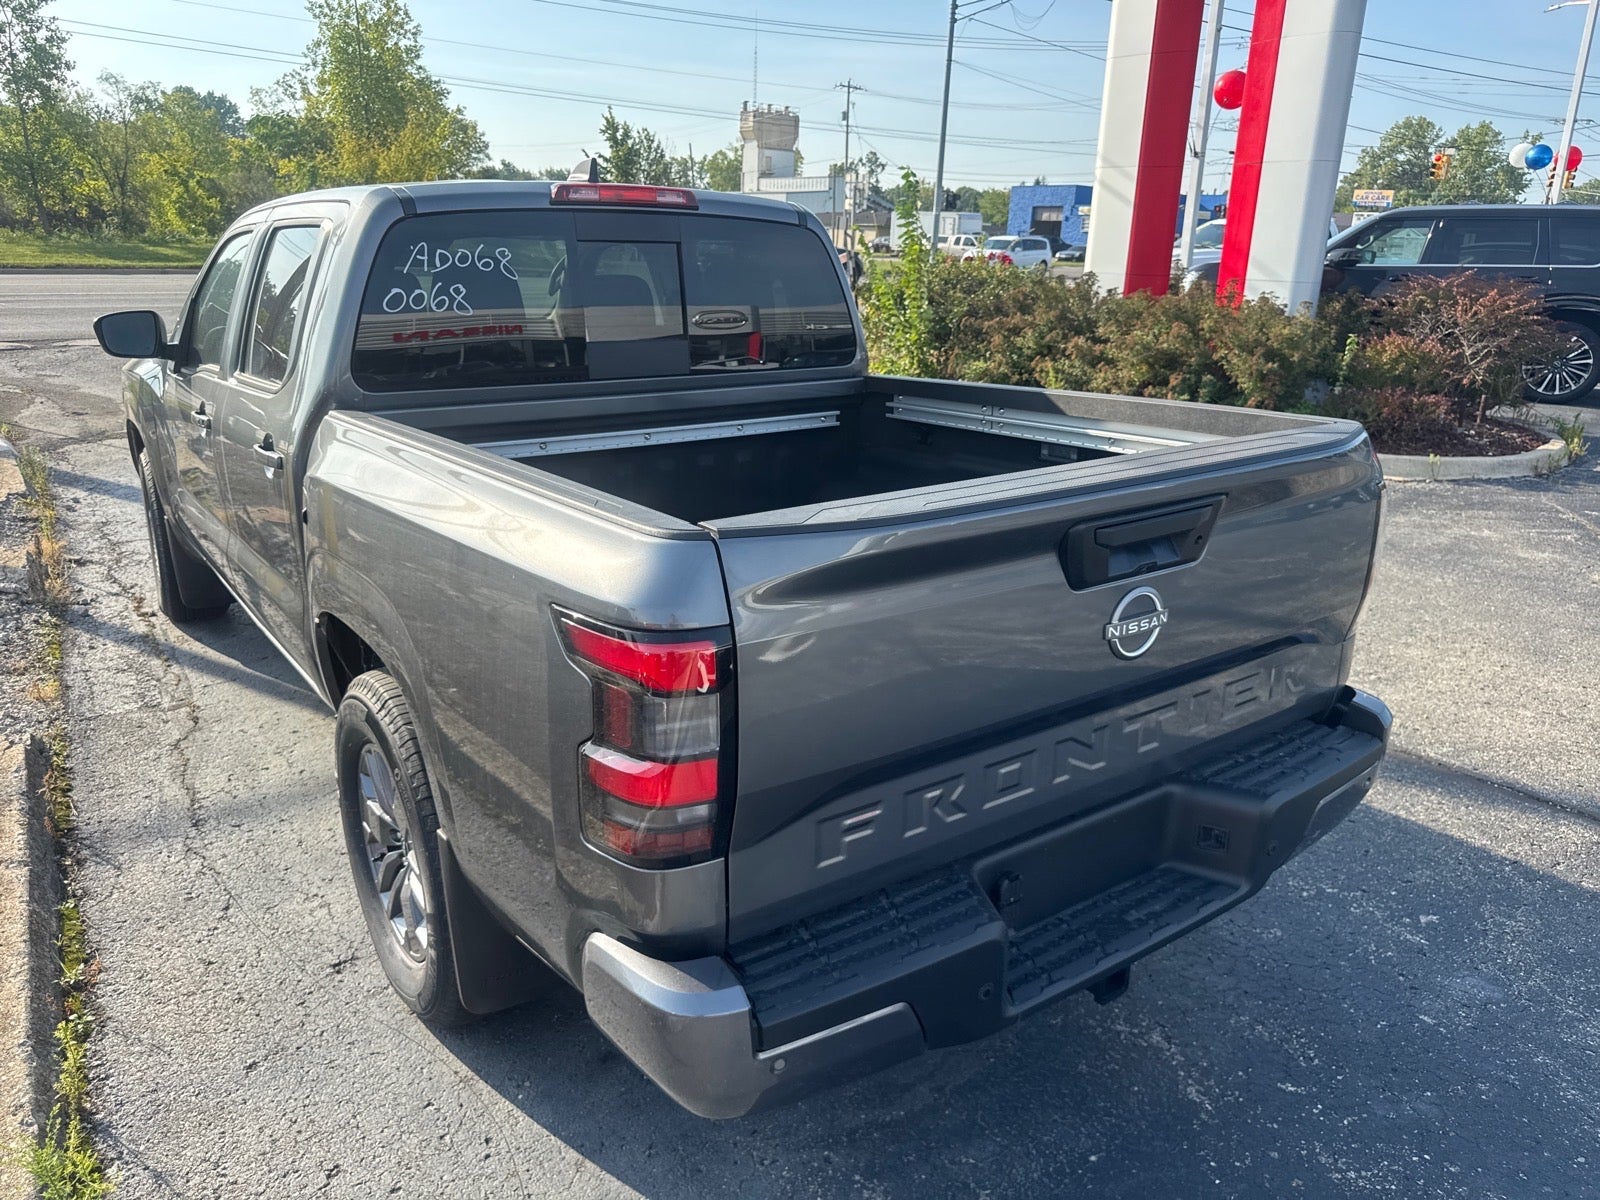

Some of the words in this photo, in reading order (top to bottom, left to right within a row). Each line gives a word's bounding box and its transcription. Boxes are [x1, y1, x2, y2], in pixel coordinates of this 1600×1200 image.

[403, 242, 518, 280] AD068
[383, 282, 473, 315] 0068
[1108, 611, 1168, 638] NISSAN
[815, 664, 1306, 868] FRONTIER
